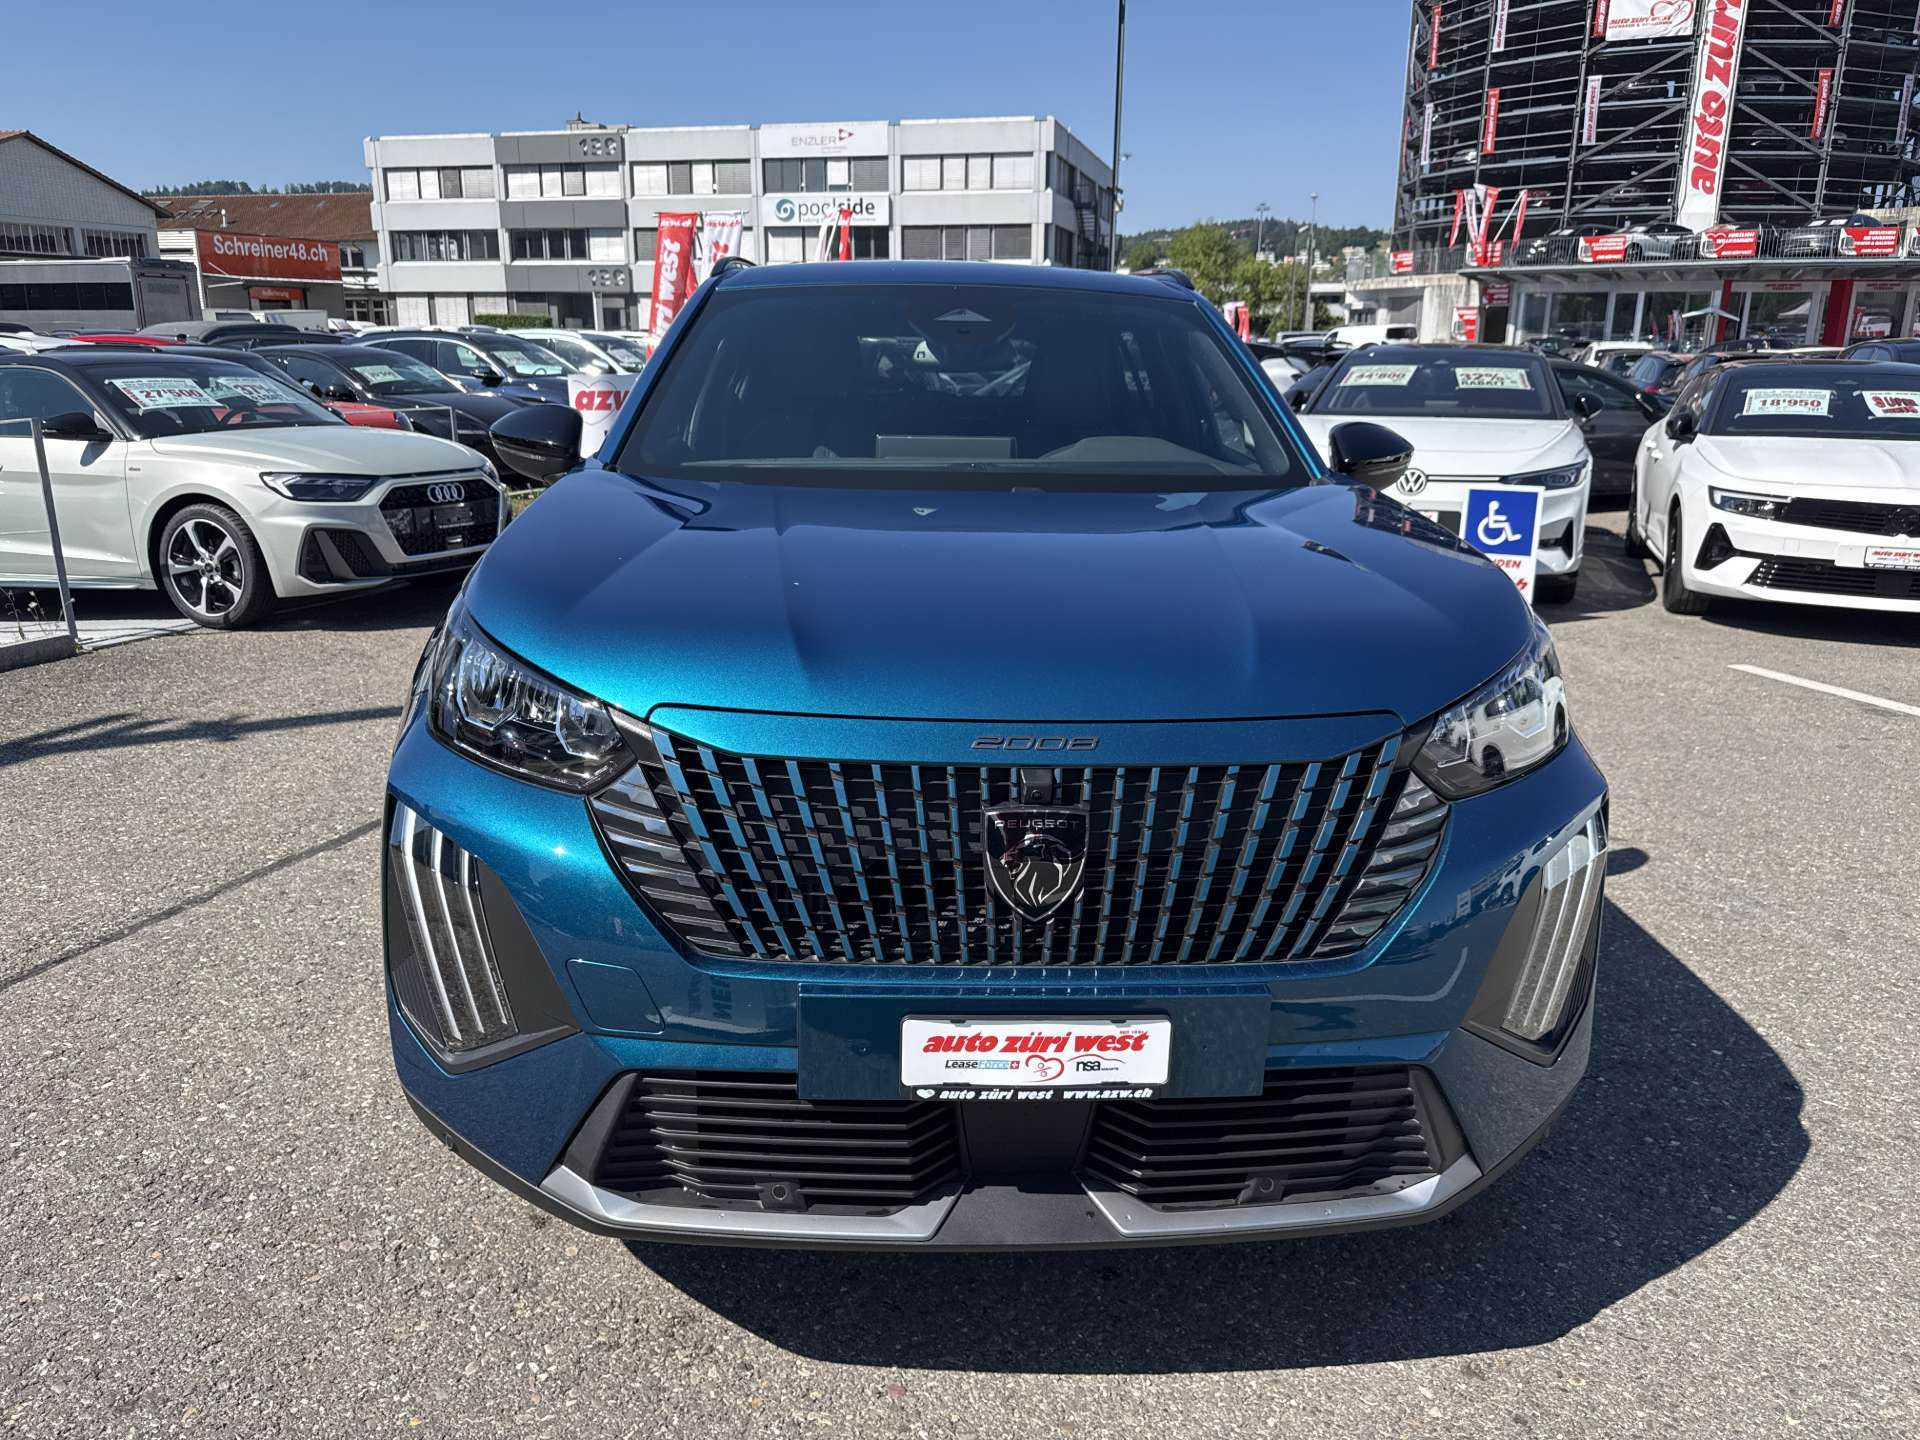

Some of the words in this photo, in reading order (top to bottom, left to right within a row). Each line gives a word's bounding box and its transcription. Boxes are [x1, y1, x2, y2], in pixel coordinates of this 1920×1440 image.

[1703, 0, 1741, 88] zür
[579, 137, 617, 156] 139
[791, 136, 838, 146] ENZLER
[1691, 91, 1726, 195] auto
[213, 235, 328, 262] Schreiner48.ch
[657, 238, 681, 301] west
[587, 269, 626, 287] 139
[139, 389, 204, 400] 27'500
[1759, 399, 1822, 407] 18'950
[1494, 559, 1521, 568] DEN
[970, 735, 1099, 751] 2008
[994, 819, 1081, 829] PEUGEOT
[923, 1032, 999, 1053] auto
[1000, 1032, 1073, 1053] züri
[1074, 1032, 1150, 1052] west
[945, 1060, 1009, 1070] LeaseForce
[1076, 1061, 1100, 1072] nsa
[939, 1090, 973, 1100] auto
[979, 1089, 1014, 1099] züri
[1018, 1090, 1053, 1100] west
[1063, 1088, 1153, 1100] www.azw.ch
